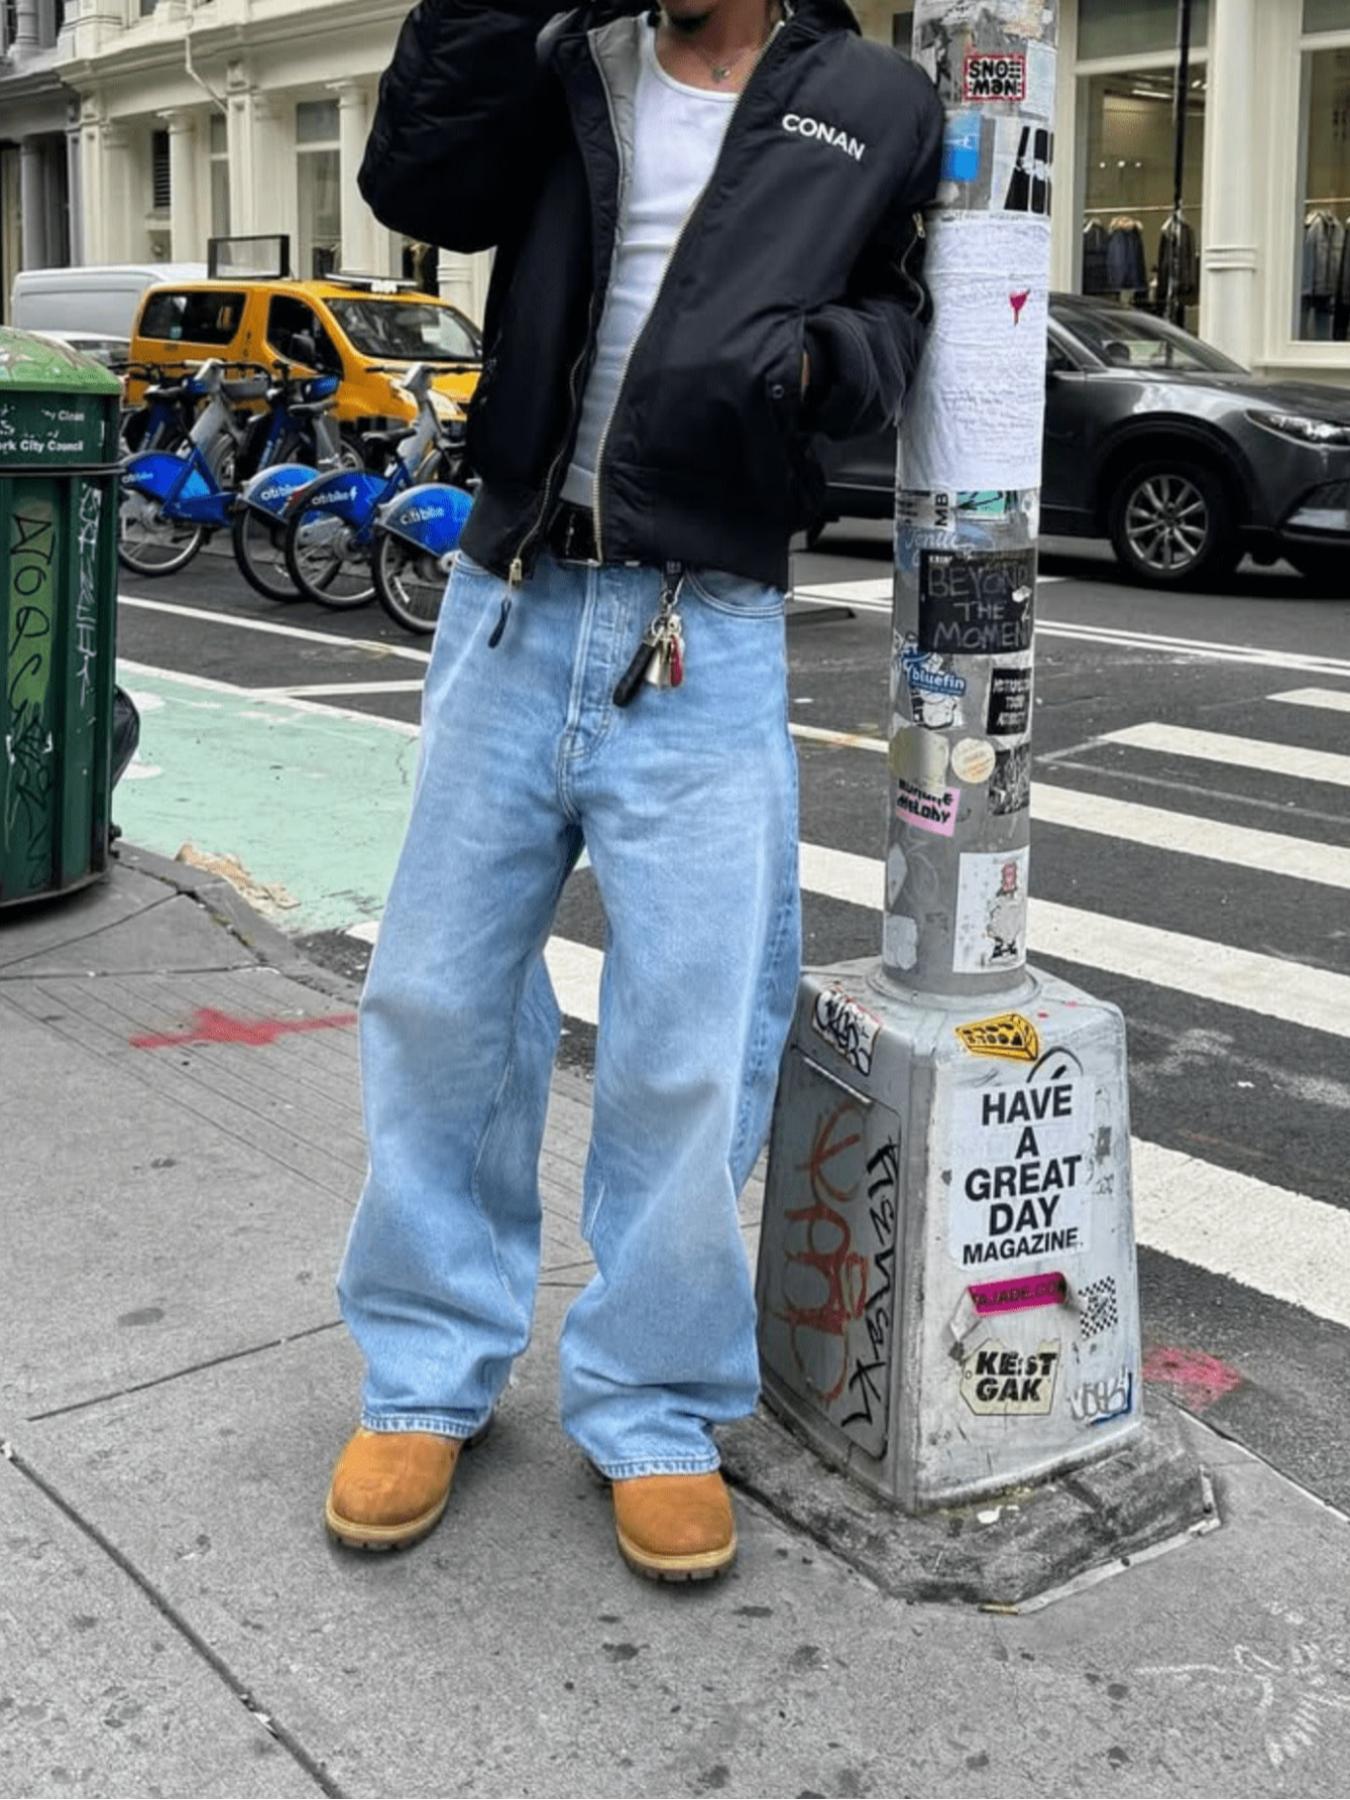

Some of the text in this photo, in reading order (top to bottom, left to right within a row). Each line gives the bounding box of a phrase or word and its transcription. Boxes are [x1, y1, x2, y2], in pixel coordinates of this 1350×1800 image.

[781, 113, 866, 161] CONAN
[20, 440, 44, 453] City
[47, 440, 83, 451] Council
[928, 564, 1029, 602] BEYOND
[953, 601, 1003, 621] THE
[912, 668, 965, 690] bluefin
[982, 1084, 1072, 1126] HAVE
[1015, 1127, 1039, 1160] A
[965, 1156, 1082, 1202] GREAT
[988, 1195, 1061, 1236] DAY
[962, 1228, 1079, 1266] MAGAZINE
[975, 1378, 1043, 1403] GAK
